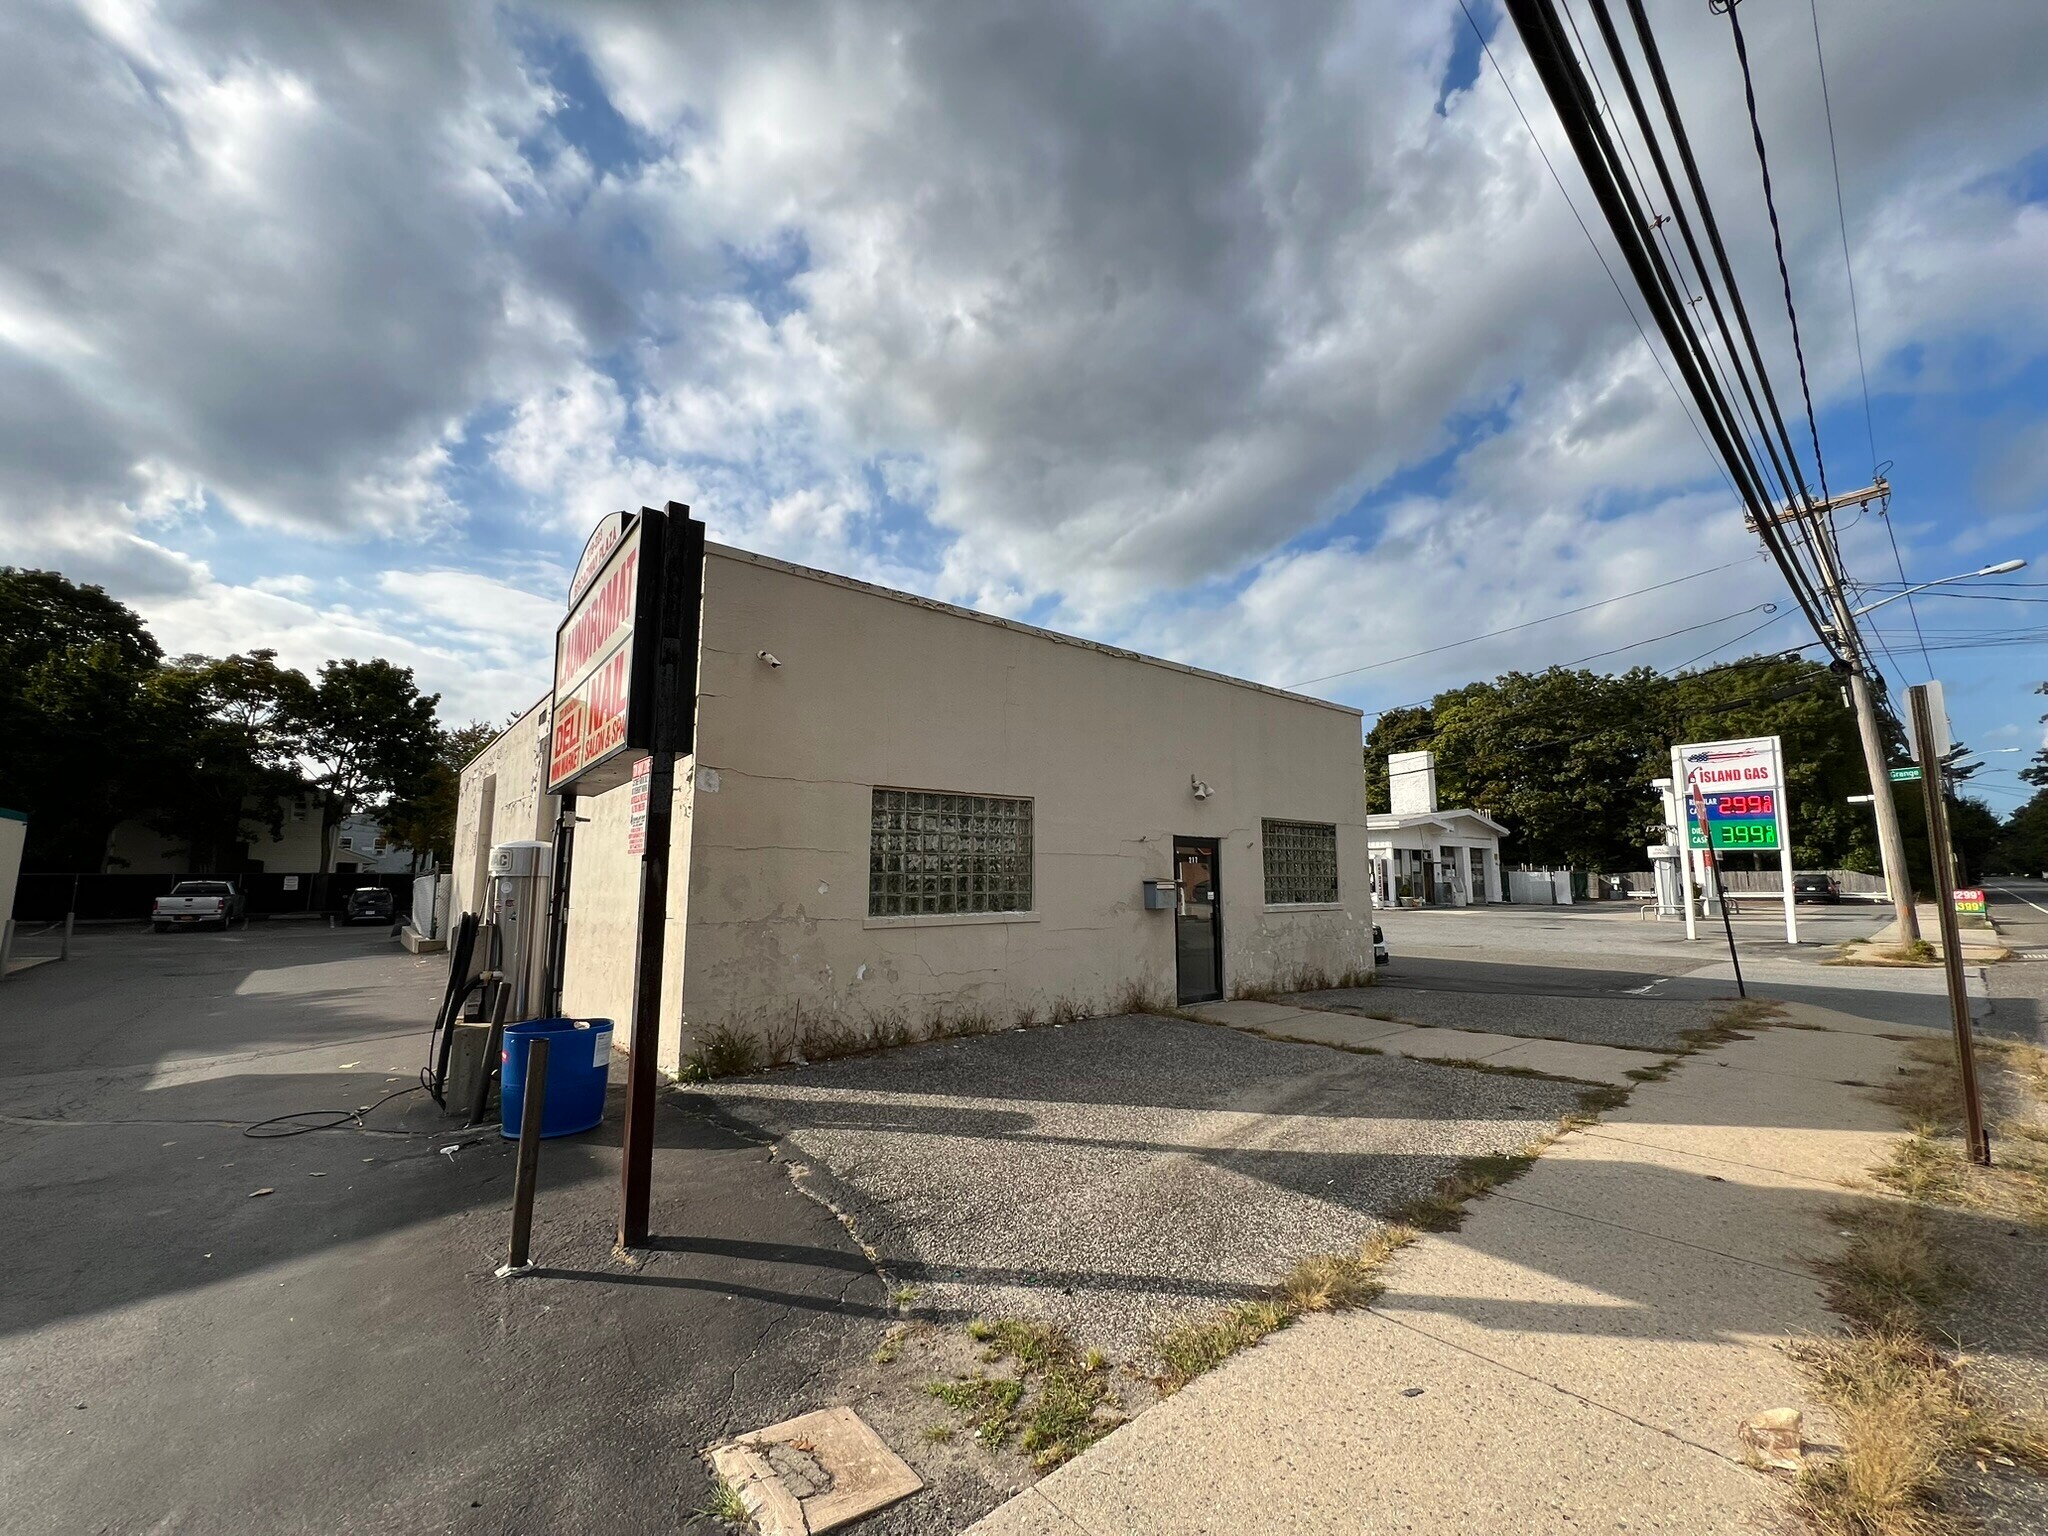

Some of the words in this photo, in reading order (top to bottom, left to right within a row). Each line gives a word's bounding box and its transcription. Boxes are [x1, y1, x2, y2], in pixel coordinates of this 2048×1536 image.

[558, 547, 637, 691] LAUNDROMAT
[588, 650, 626, 736] NAIL
[555, 707, 582, 759] DELI
[585, 728, 605, 761] SALON
[605, 725, 611, 748] &
[612, 714, 625, 744] SPA
[561, 745, 581, 778] MARKET
[1700, 769, 1741, 783] ISLAND
[1744, 767, 1769, 780] GAS
[1891, 770, 1919, 778] Grange
